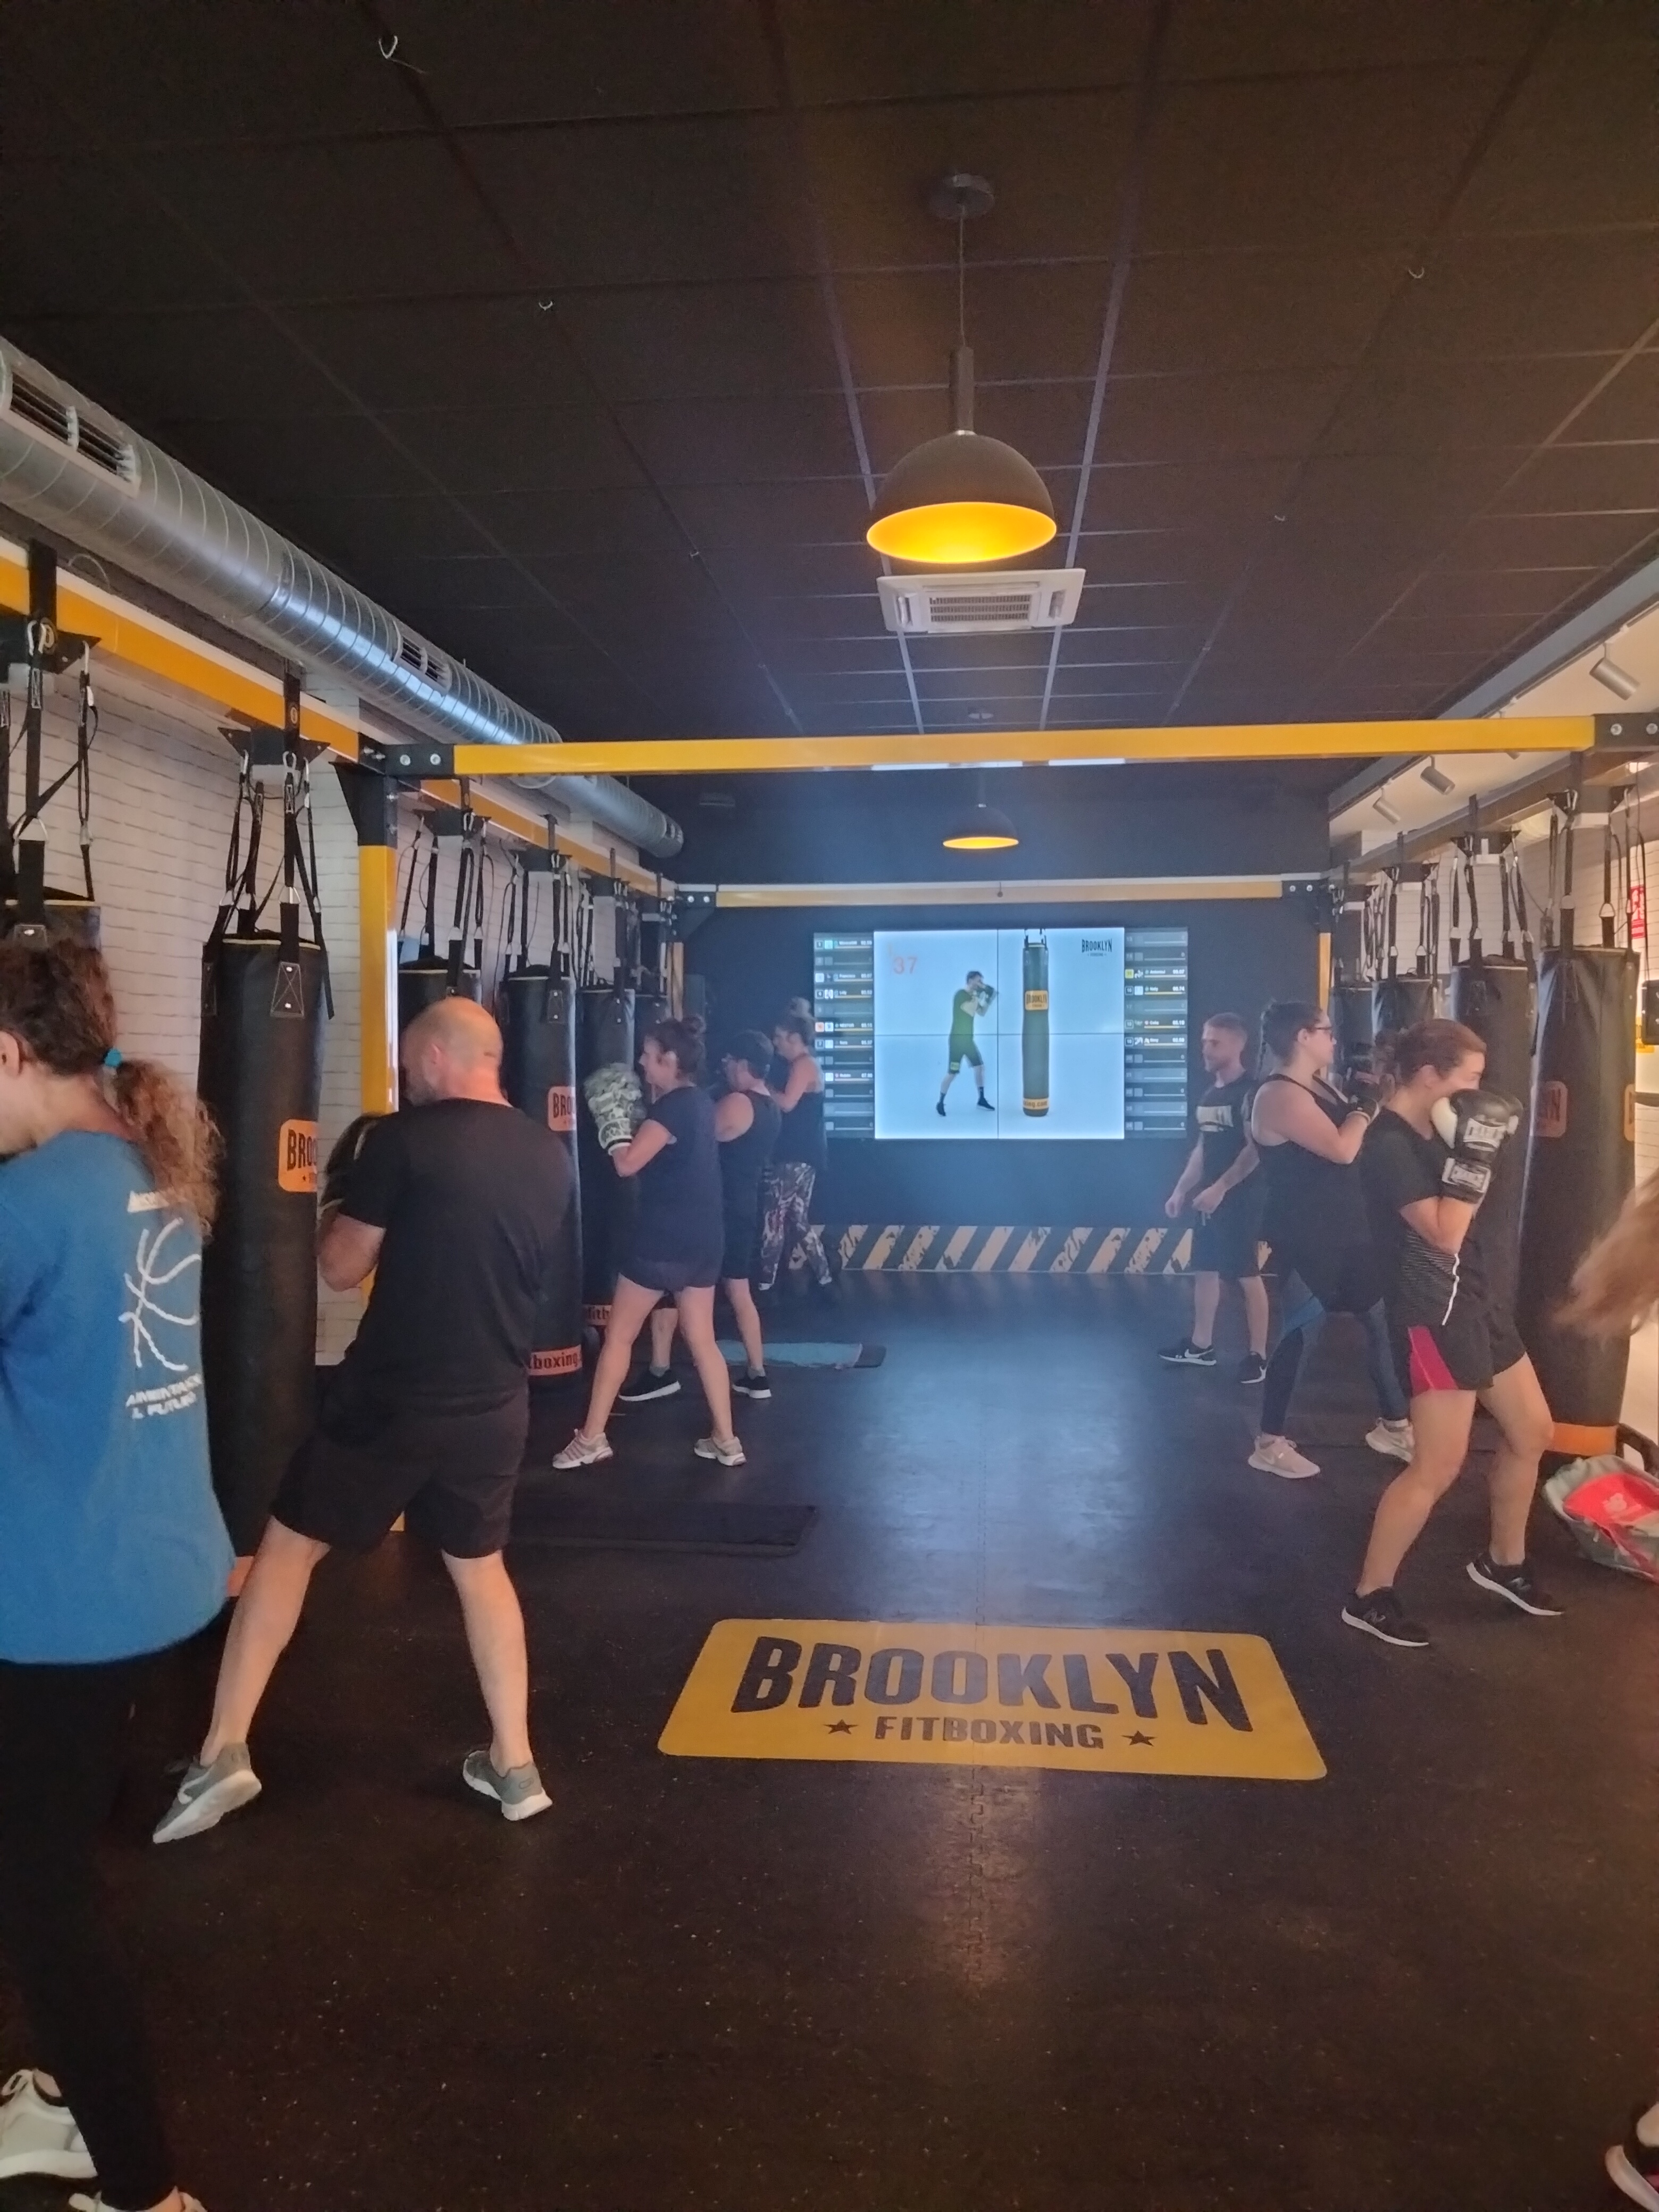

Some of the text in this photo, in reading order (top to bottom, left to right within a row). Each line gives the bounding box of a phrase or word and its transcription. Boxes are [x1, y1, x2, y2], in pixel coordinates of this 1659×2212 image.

[1082, 939, 1112, 953] BROOKLYN
[893, 956, 918, 974] 37
[529, 1352, 578, 1369] boxing
[731, 1636, 1253, 1732] BROOKLYN
[875, 1716, 1103, 1749] FITBOXING
